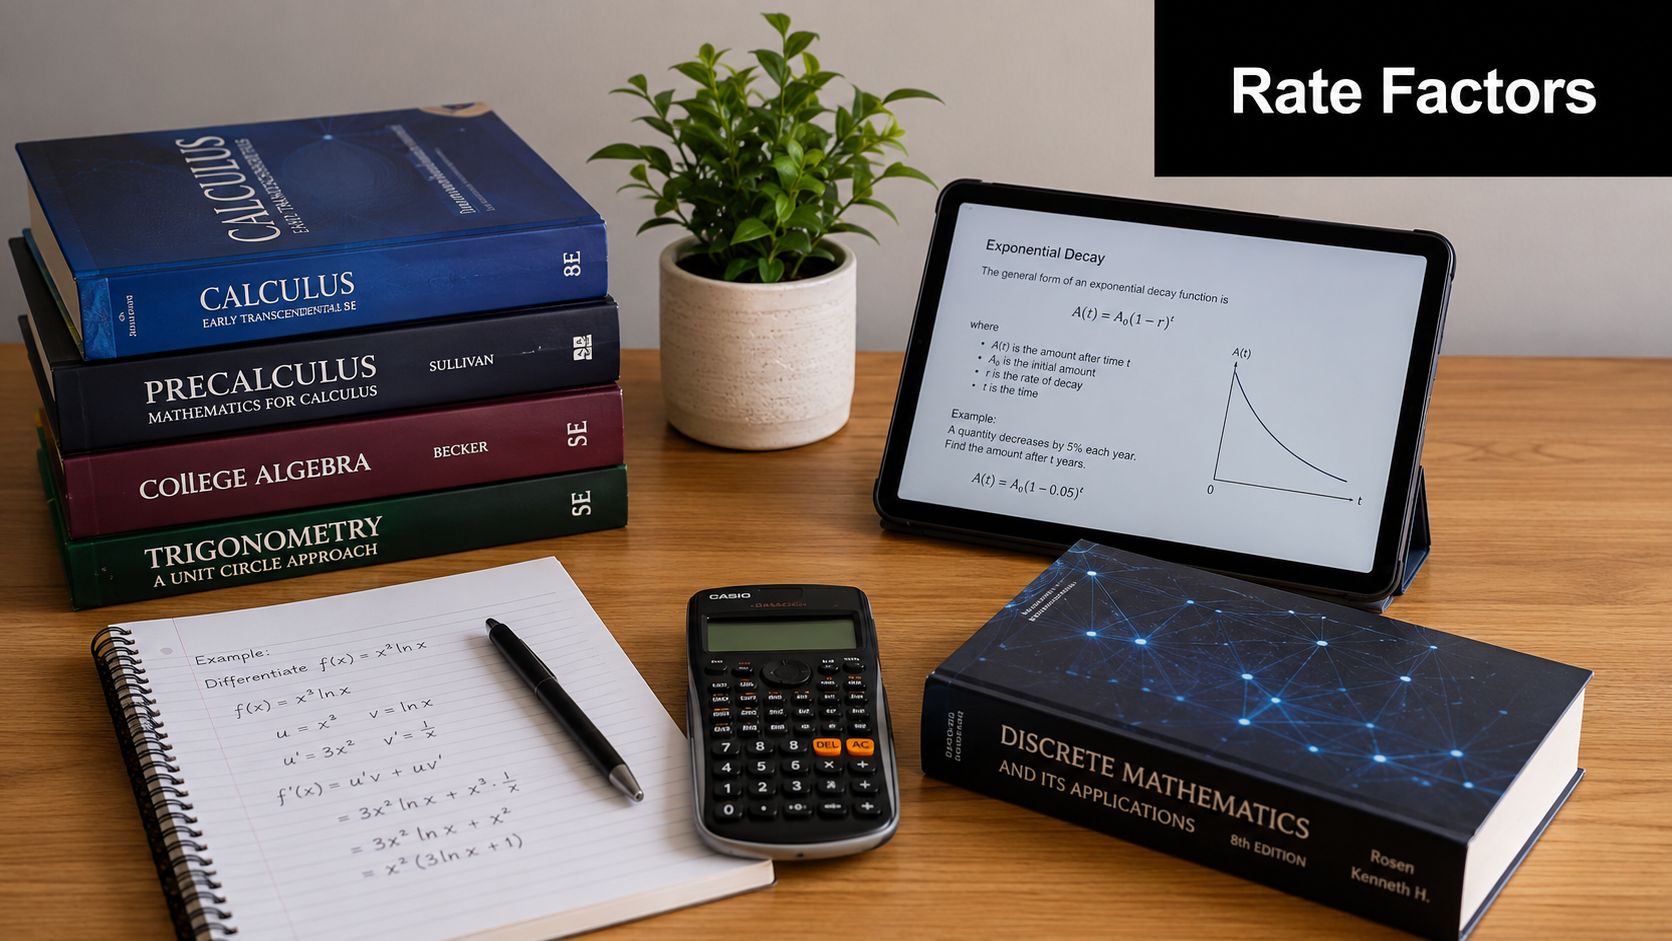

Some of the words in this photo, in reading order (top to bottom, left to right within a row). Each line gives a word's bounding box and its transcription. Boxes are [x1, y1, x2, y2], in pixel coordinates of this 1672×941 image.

[175, 136, 281, 242] CALCULUS
[563, 250, 581, 277] 8E
[986, 238, 1061, 259] Exponential
[1064, 249, 1106, 266] Decay
[200, 272, 355, 311] CALCULUS
[981, 266, 999, 277] The
[1002, 268, 1037, 280] general
[1039, 273, 1061, 284] form
[1063, 276, 1074, 286] of
[1075, 279, 1086, 287] an
[1090, 279, 1145, 294] exponential
[1148, 286, 1177, 299] decay
[1179, 290, 1218, 303] function
[1220, 295, 1229, 304] is
[203, 316, 237, 328] EARLY
[970, 321, 999, 331] where
[1072, 306, 1098, 321] A(t)
[429, 354, 494, 372] SULLIVAN
[991, 340, 1010, 351] A(t)
[1012, 344, 1020, 352] is
[1022, 345, 1038, 355] the
[1040, 349, 1076, 361] amount
[1078, 352, 1101, 363] after
[1103, 356, 1124, 367] time
[1126, 359, 1131, 367] t
[1232, 348, 1251, 359] A(t)
[144, 355, 377, 404] PRECALCULUS
[1003, 357, 1011, 365] is
[1014, 358, 1028, 368] the
[1031, 361, 1057, 372] initial
[1059, 365, 1096, 377] amount
[983, 383, 987, 391] t
[989, 383, 997, 392] is
[1000, 385, 1015, 395] the
[1018, 387, 1038, 398] time
[992, 370, 1000, 378] is
[1003, 371, 1018, 381] the
[1020, 374, 1039, 384] rate
[1042, 376, 1052, 385] of
[1054, 379, 1083, 391] decay
[148, 400, 260, 424] MATHEMATICS
[266, 396, 296, 409] FOR
[300, 385, 378, 405] CALCULUS
[951, 409, 997, 424] Example:
[567, 420, 588, 446] SE
[947, 425, 955, 434] A
[958, 426, 997, 441] quantity
[999, 434, 1050, 448] decreases
[1052, 440, 1064, 452] by
[1066, 442, 1083, 453] 5%
[1086, 446, 1110, 457] each
[1112, 450, 1136, 461] year.
[434, 442, 488, 458] BECKER
[945, 440, 966, 451] Find
[968, 443, 984, 453] the
[986, 446, 1023, 459] amount
[1025, 451, 1048, 463] after
[1050, 455, 1054, 464] t
[1056, 457, 1086, 469] years.
[255, 453, 372, 485] ALGEBRA
[971, 472, 996, 488] A(t)
[571, 490, 591, 516] SE
[1358, 496, 1362, 505] t
[144, 516, 382, 569] TRIGONOMETRY
[153, 575, 166, 588] A
[171, 568, 215, 584] UNIT
[220, 558, 282, 577] CIRCLE
[286, 543, 378, 569] APPROACH
[195, 649, 270, 666] Example:
[204, 663, 308, 689] Differentiate
[319, 653, 354, 672] f(x)
[397, 643, 412, 652] ln
[417, 641, 427, 650] x
[235, 700, 271, 719] f(x)
[318, 688, 335, 700] ln
[340, 686, 351, 696] x
[369, 710, 379, 719] v
[400, 702, 418, 713] ln
[423, 700, 433, 708] x
[276, 730, 290, 739] u
[721, 743, 731, 752] 7
[756, 742, 765, 750] 8
[789, 741, 798, 750] 8
[722, 763, 732, 772] 4
[757, 762, 766, 771] 5
[791, 761, 800, 770] 6
[277, 782, 323, 806] f'(x)
[724, 784, 730, 793] 1
[758, 782, 767, 792] 2
[792, 781, 801, 791] 3
[1001, 724, 1115, 778] DISCRETE
[1122, 762, 1310, 839] MATHEMATICS
[360, 800, 392, 820] 3x²
[400, 798, 418, 811] ln
[424, 795, 436, 805] x
[998, 760, 1036, 782] AND
[1041, 772, 1065, 791] ITS
[1070, 782, 1195, 832] APPLICATIONS
[724, 805, 733, 815] 0
[373, 830, 408, 851] 3x²
[417, 827, 437, 841] ln
[444, 825, 457, 834] x
[490, 807, 511, 825] x²
[387, 858, 408, 876] x²
[467, 847, 479, 858] x
[506, 833, 523, 848] 1)
[1230, 834, 1250, 850] 8th
[1254, 842, 1306, 868] EDITION
[1370, 849, 1414, 875] Rosen
[1351, 866, 1410, 898] Kenneth
[1414, 886, 1430, 904] H.
